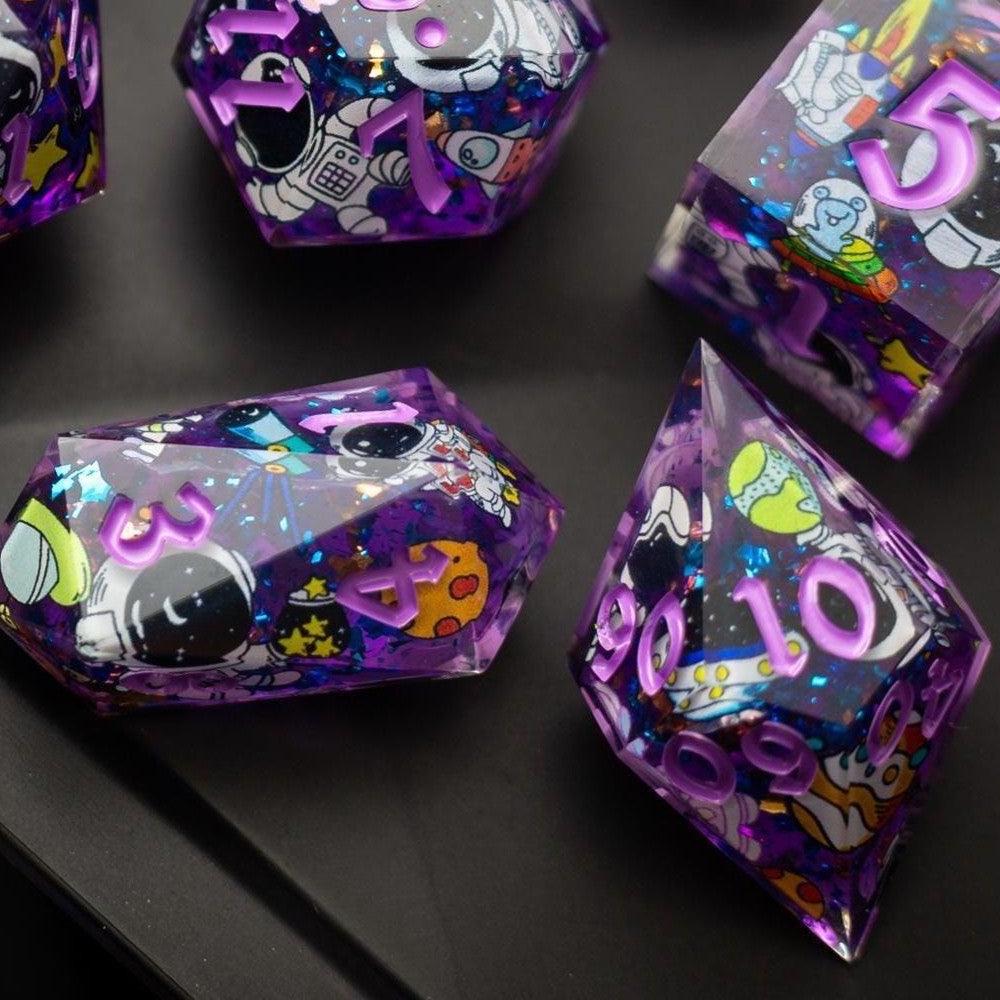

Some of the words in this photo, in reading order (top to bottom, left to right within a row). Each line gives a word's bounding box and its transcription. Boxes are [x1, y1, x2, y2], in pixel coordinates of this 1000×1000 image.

[849, 58, 1000, 210] 5
[101, 481, 217, 569] 3
[333, 542, 451, 629] 4
[591, 582, 686, 696] 90
[731, 555, 876, 677] 10
